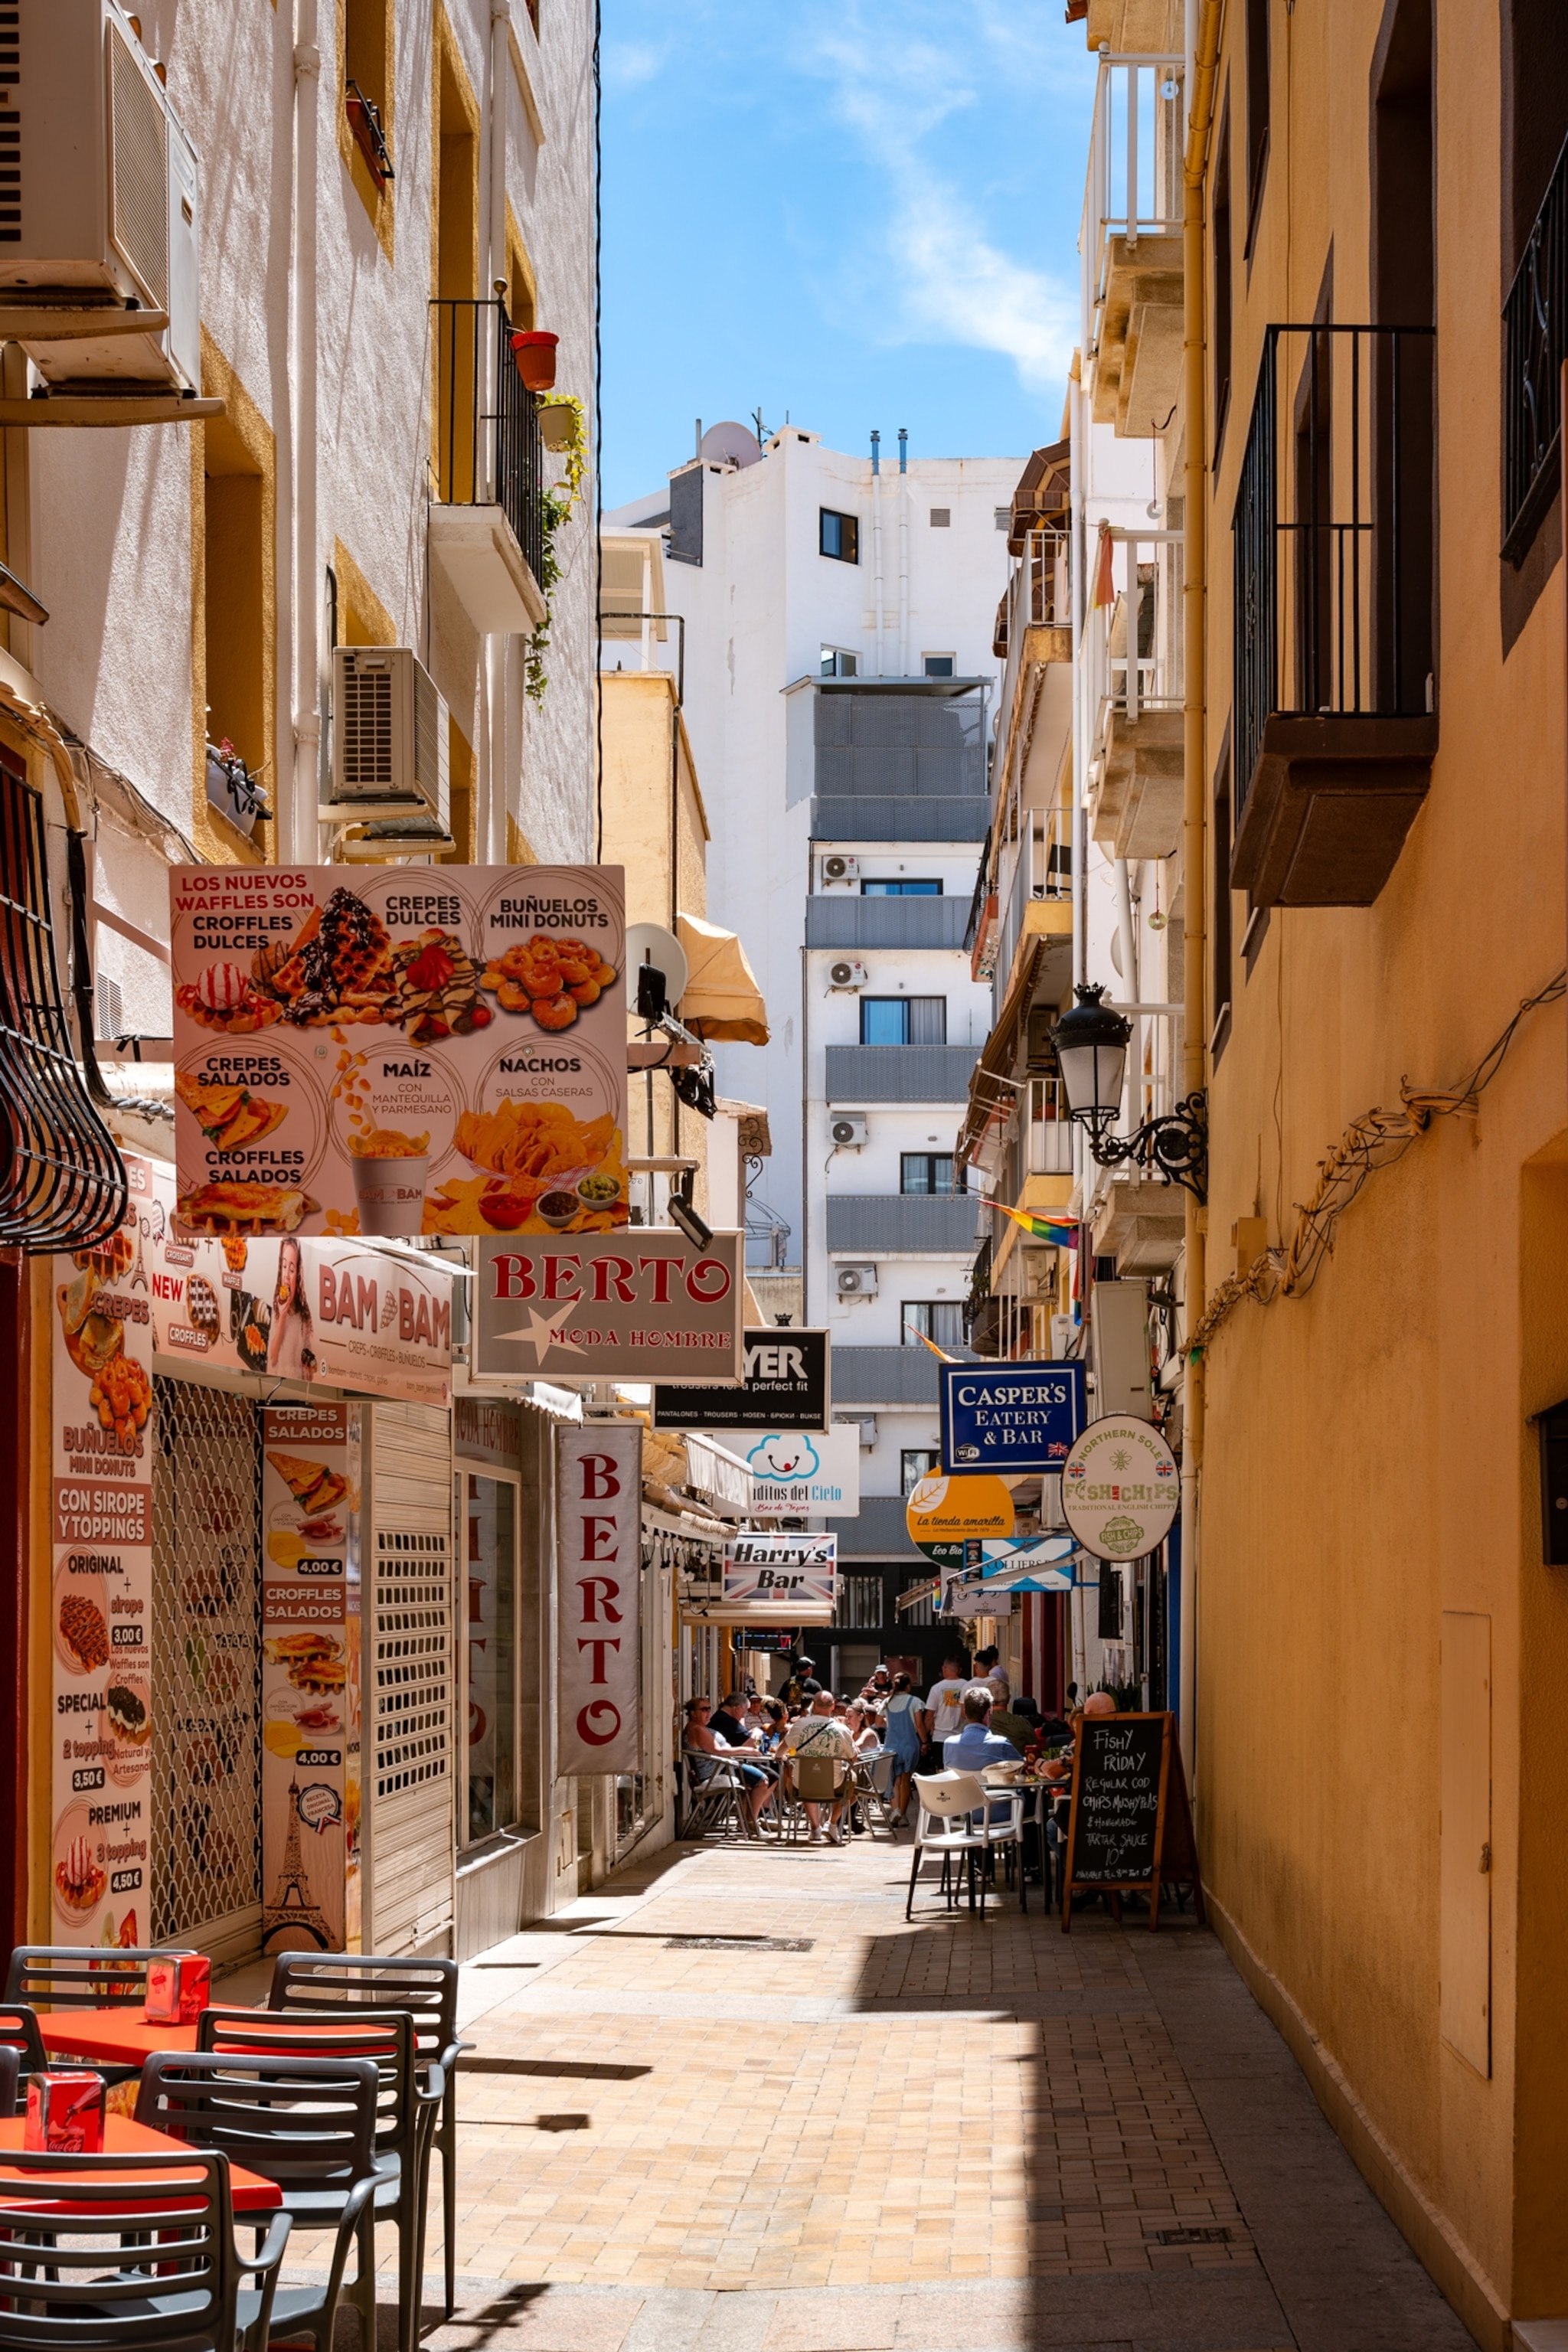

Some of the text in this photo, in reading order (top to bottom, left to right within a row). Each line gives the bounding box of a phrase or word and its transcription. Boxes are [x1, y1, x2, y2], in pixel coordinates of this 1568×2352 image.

[182, 874, 306, 892] LOS NUEVOS
[175, 893, 314, 911] WAFFLES SON
[386, 896, 461, 910] CREPES
[500, 895, 598, 913] BUÑUELOS
[193, 916, 292, 931] CROFFLES
[386, 911, 461, 926] DULCES
[490, 913, 609, 929] MINI DONUTS
[194, 935, 270, 949] DULCES
[207, 1057, 282, 1072] CREPES
[384, 1058, 432, 1078] MAÍZ
[499, 1058, 581, 1073] NACHOS
[198, 1072, 291, 1086] SALADOS
[531, 1076, 554, 1086] CON
[398, 1083, 422, 1093] CON
[496, 1087, 593, 1098] SALSAS CASERAS
[373, 1094, 451, 1104] MANTEQUILLA
[372, 1104, 452, 1114] Y PARMESANO
[205, 1151, 304, 1165] CROFFLES
[209, 1170, 302, 1184] SALADOS
[397, 1188, 423, 1199] BAM
[166, 1250, 191, 1263] CROISSANT
[488, 1253, 732, 1303] BERTO
[152, 1273, 184, 1302] NEW
[93, 1291, 150, 1324] CREPES
[319, 1263, 450, 1351] BAM BAM
[169, 1326, 207, 1348] CROFFLES
[549, 1328, 732, 1349] MODA HOMBRE
[743, 1345, 808, 1378] YER
[742, 1382, 749, 1390] a
[753, 1380, 793, 1392] perfect
[796, 1380, 808, 1392] fit
[959, 1383, 1067, 1406] CASPER'S
[276, 1409, 338, 1422] CREPES
[975, 1410, 1052, 1427] EATERY
[63, 1422, 144, 1457] BUÑUELOS
[268, 1426, 345, 1439] SALADOS
[983, 1429, 1043, 1445] & BAR
[1078, 1429, 1162, 1462] NORTHERN SOLE
[69, 1455, 136, 1478] MINI DONUTS
[791, 1485, 808, 1501] del
[812, 1485, 841, 1501] Cielo
[1121, 1484, 1178, 1502] CHIPS
[58, 1488, 145, 1515] CON SIROPE
[58, 1515, 145, 1541] Y TOPPINGS
[917, 1516, 1005, 1526] La tienda amarilla
[1101, 1532, 1116, 1542] FISH
[1123, 1528, 1142, 1539] CHIPS
[734, 1544, 828, 1566] Harry's
[933, 1545, 947, 1556] Eco
[949, 1545, 963, 1555] Bio
[68, 1555, 123, 1575] ORIGINAL
[299, 1561, 340, 1574] 4,00 €
[758, 1570, 804, 1589] Bar
[266, 1588, 341, 1602] CROFFLES
[576, 1453, 624, 1746] BERTO
[111, 1594, 144, 1619] sirope
[266, 1606, 342, 1619] SALADOS
[114, 1628, 141, 1644] 3,00 €
[111, 1645, 149, 1655] Los nuevos
[109, 1658, 150, 1671] Waffles son
[116, 1674, 143, 1684] Croffles
[57, 1692, 106, 1714] SPECIAL
[63, 1738, 116, 1762] 2 topping
[115, 1746, 142, 1760] Natural
[298, 1753, 338, 1765] 4,00 €
[74, 1772, 103, 1788] 3,50 €
[1132, 1778, 1150, 1788] COD
[88, 1801, 141, 1827] PREMIUM
[1086, 1833, 1148, 1847] TARTAR SAUCE
[96, 1838, 147, 1863] 3 topping
[113, 1873, 139, 1892] 4,50 €
